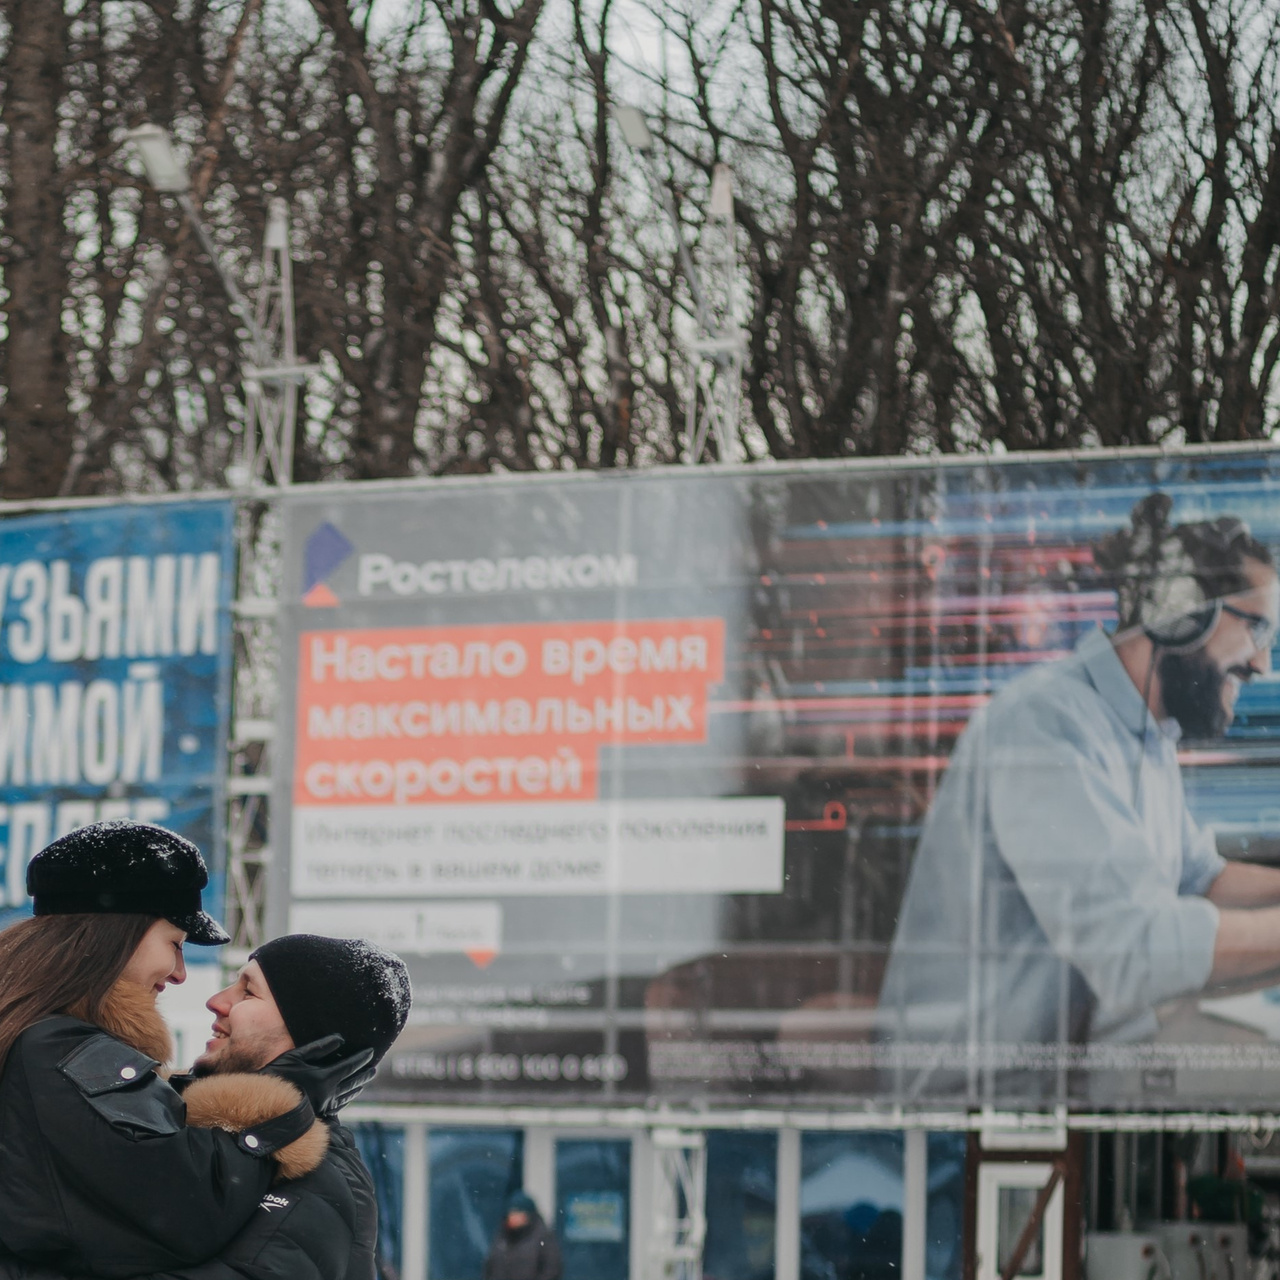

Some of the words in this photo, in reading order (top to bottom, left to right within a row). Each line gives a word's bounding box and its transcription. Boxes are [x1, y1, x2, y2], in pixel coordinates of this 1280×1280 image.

[357, 553, 638, 596] Ростелеком
[310, 637, 528, 682] Настало
[541, 634, 708, 685] время
[307, 694, 694, 740] максимальных
[303, 747, 582, 802] скоростей
